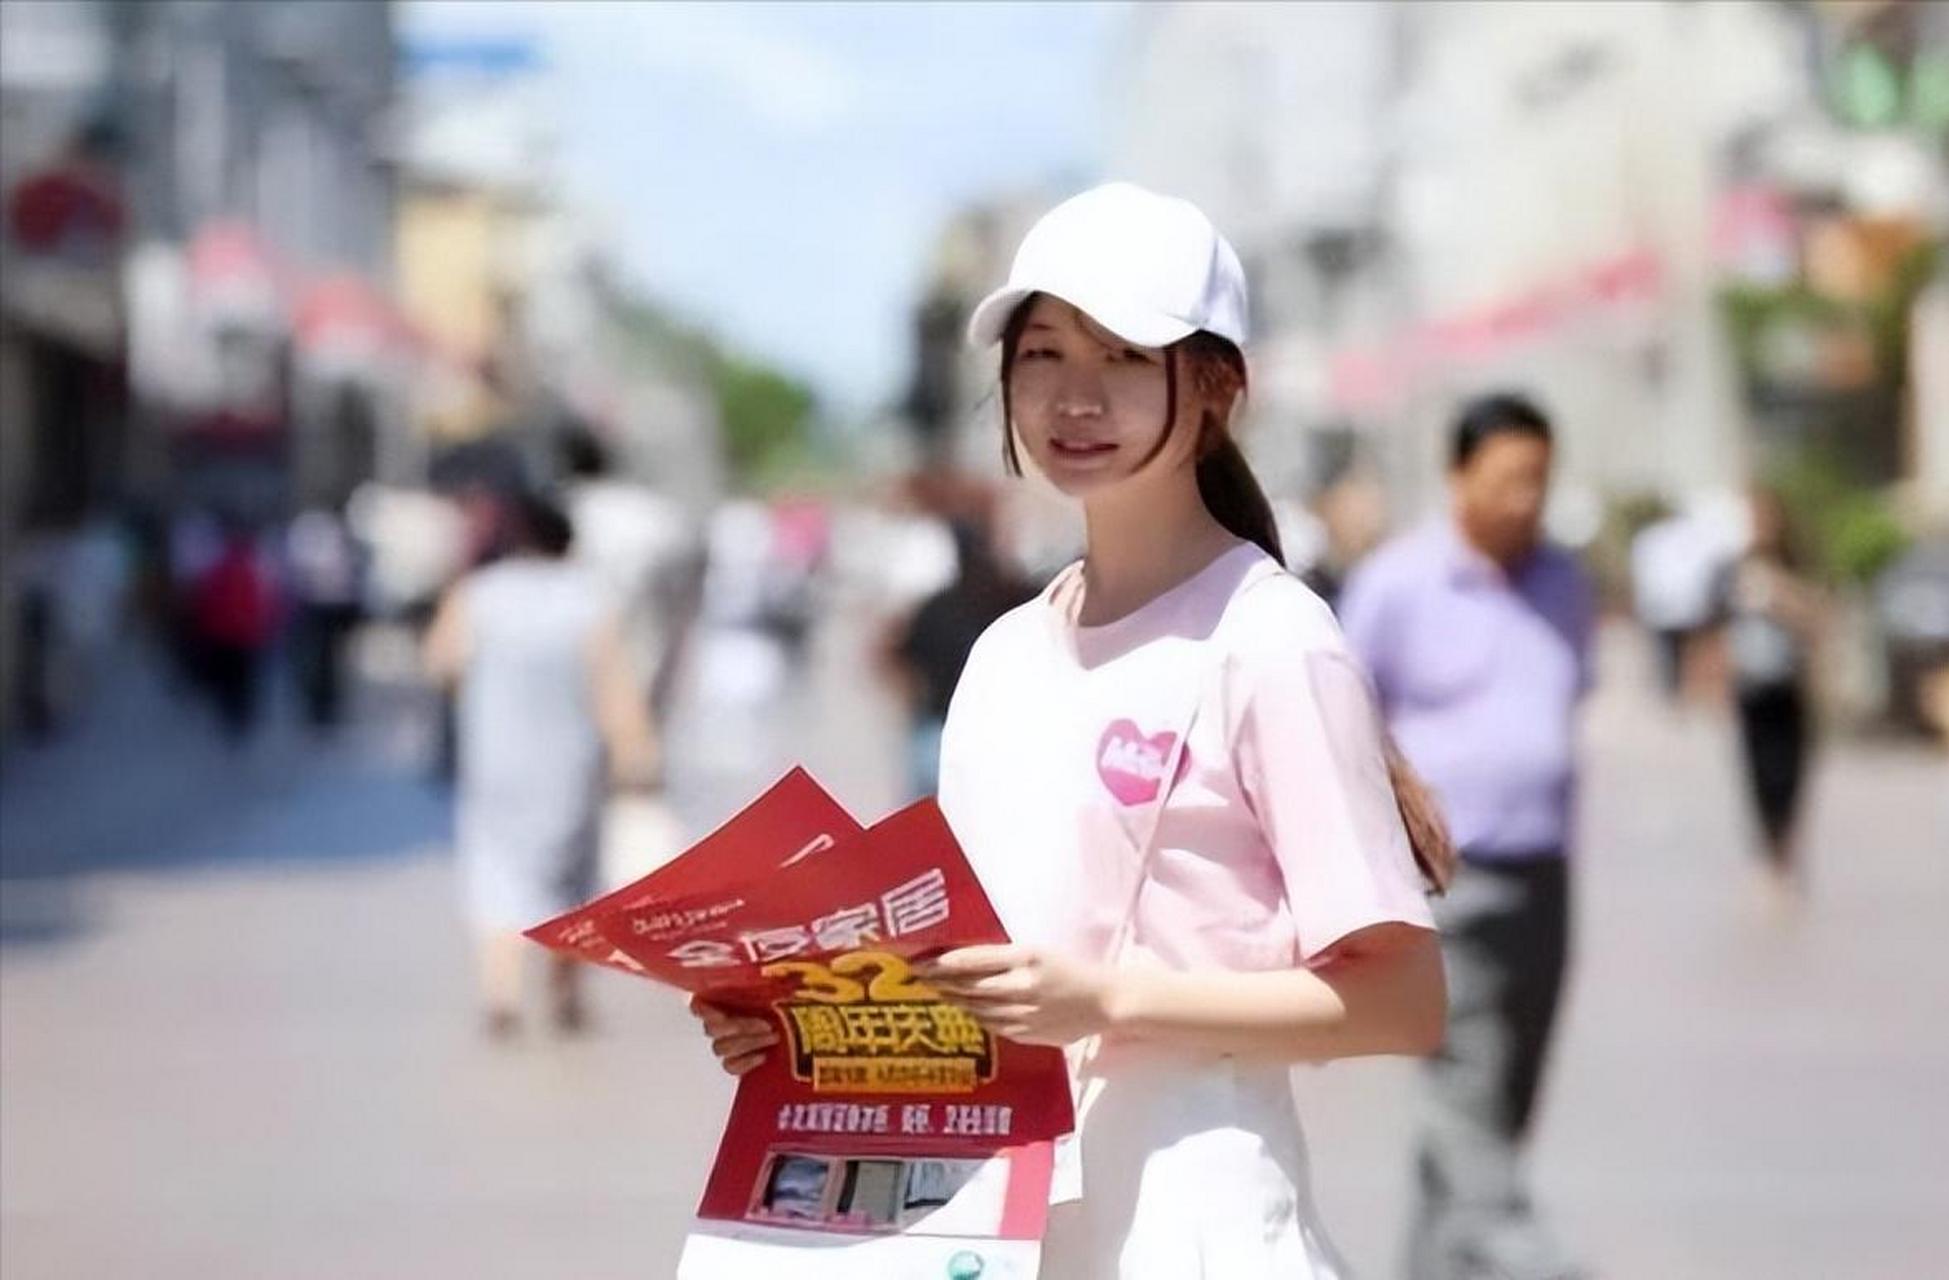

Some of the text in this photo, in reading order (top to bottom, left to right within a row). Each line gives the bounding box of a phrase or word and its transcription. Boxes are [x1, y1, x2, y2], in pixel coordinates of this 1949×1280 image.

[760, 950, 941, 1001] 32
[790, 1003, 987, 1055] 周年庆典
